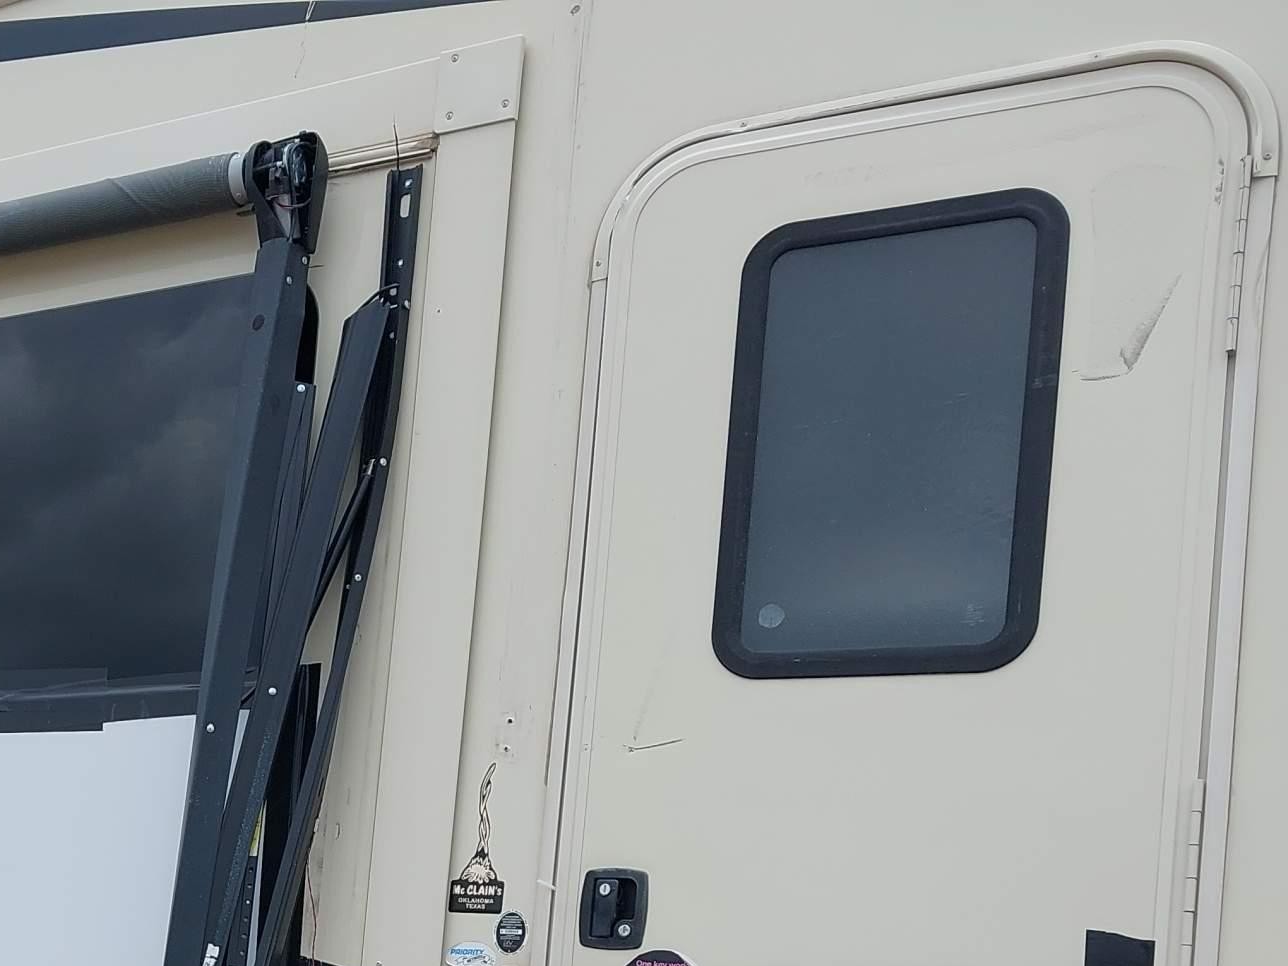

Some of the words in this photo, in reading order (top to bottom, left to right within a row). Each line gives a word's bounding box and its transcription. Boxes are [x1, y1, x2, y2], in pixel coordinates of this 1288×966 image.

[453, 885, 465, 895] Mc
[466, 885, 502, 896] CLAIN's
[450, 948, 485, 956] PRIORITY
